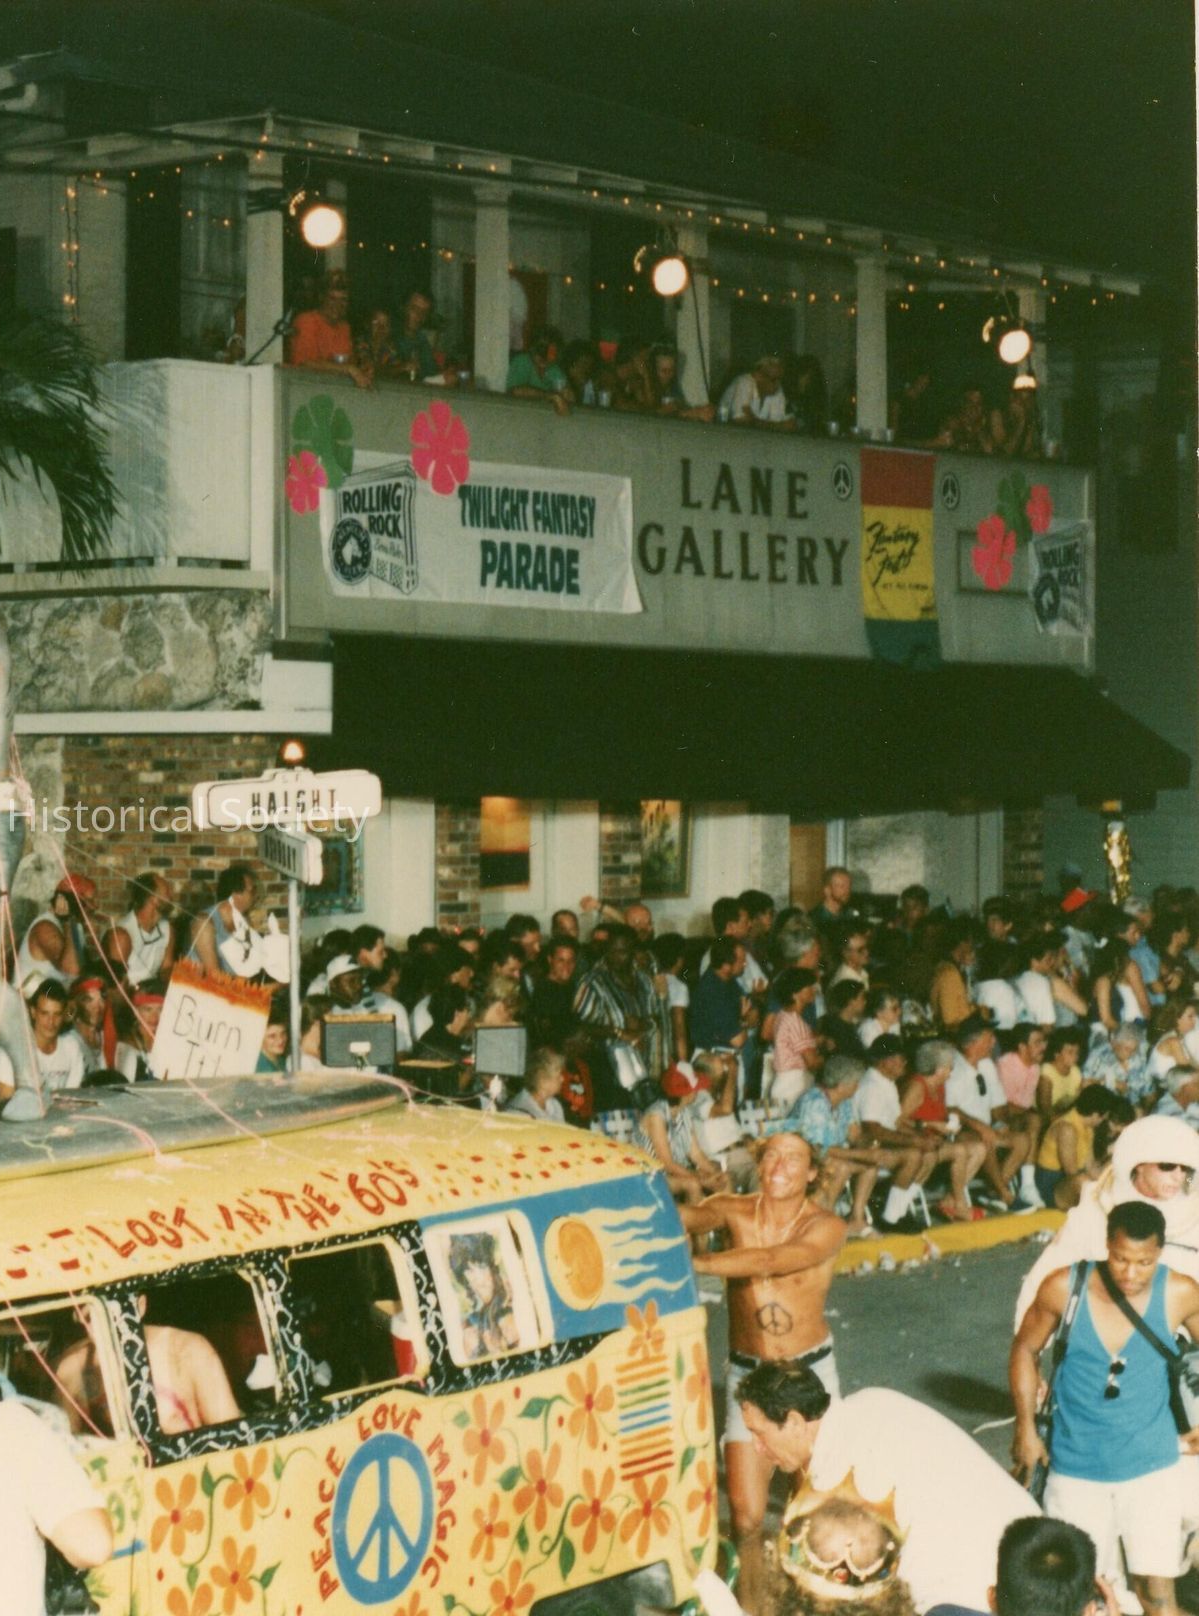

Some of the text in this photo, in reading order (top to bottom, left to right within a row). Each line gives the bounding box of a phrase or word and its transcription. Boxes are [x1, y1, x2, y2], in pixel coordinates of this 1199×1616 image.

[342, 482, 402, 513] ROLLING
[458, 484, 596, 538] TWILIGHT FANTASY
[680, 457, 808, 519] LANE
[368, 514, 403, 539] ROCK
[637, 522, 849, 586] GALLERY
[480, 539, 580, 595] PARADE
[251, 789, 336, 817] HAIGHT
[173, 994, 241, 1050] Burn
[86, 1206, 209, 1258] LOST
[217, 1198, 270, 1235] IN
[259, 1183, 341, 1231] THE
[357, 1403, 422, 1442] LOVE
[311, 1446, 346, 1600] PEACE
[421, 1433, 456, 1588] MAGIC
